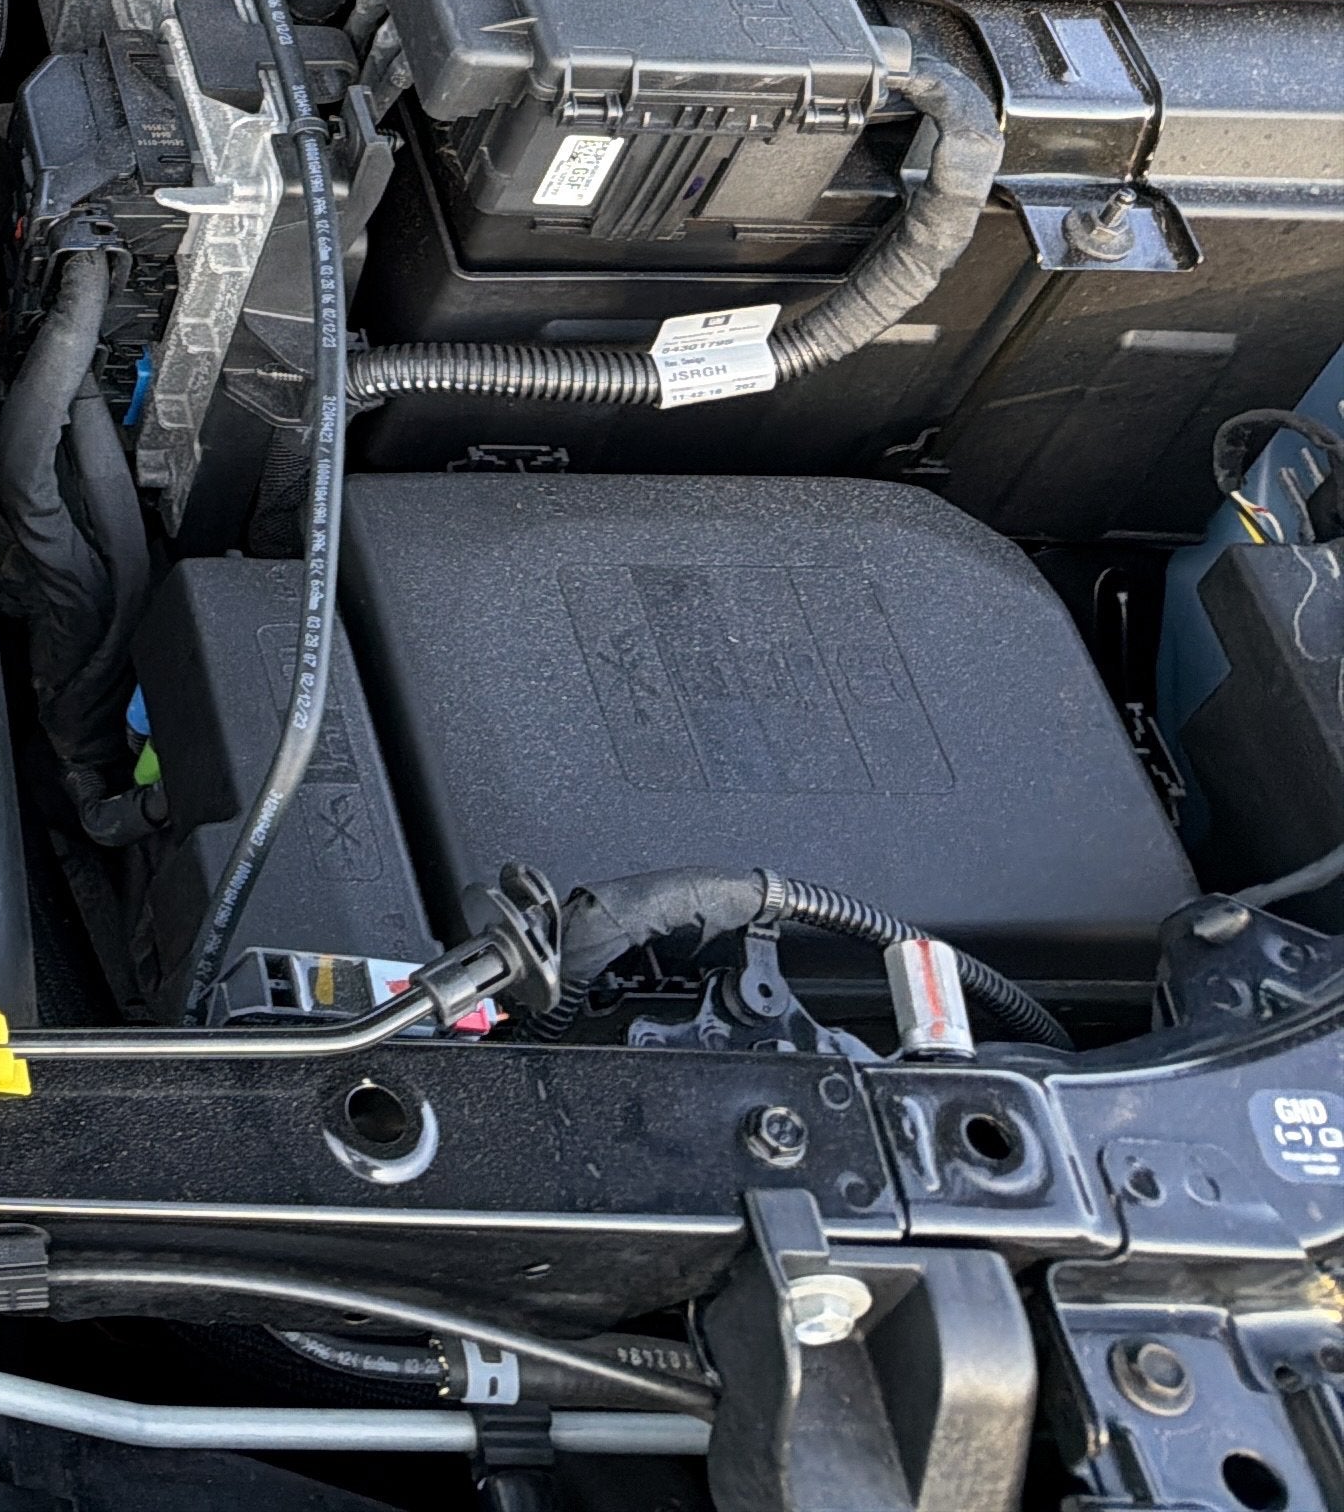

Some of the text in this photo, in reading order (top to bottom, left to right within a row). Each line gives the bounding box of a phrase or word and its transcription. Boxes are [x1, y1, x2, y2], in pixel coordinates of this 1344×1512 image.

[321, 307, 337, 347] 02/12/23
[669, 364, 728, 383] JSRGH
[292, 670, 317, 731] 02/12/23
[1274, 1097, 1328, 1125] GND
